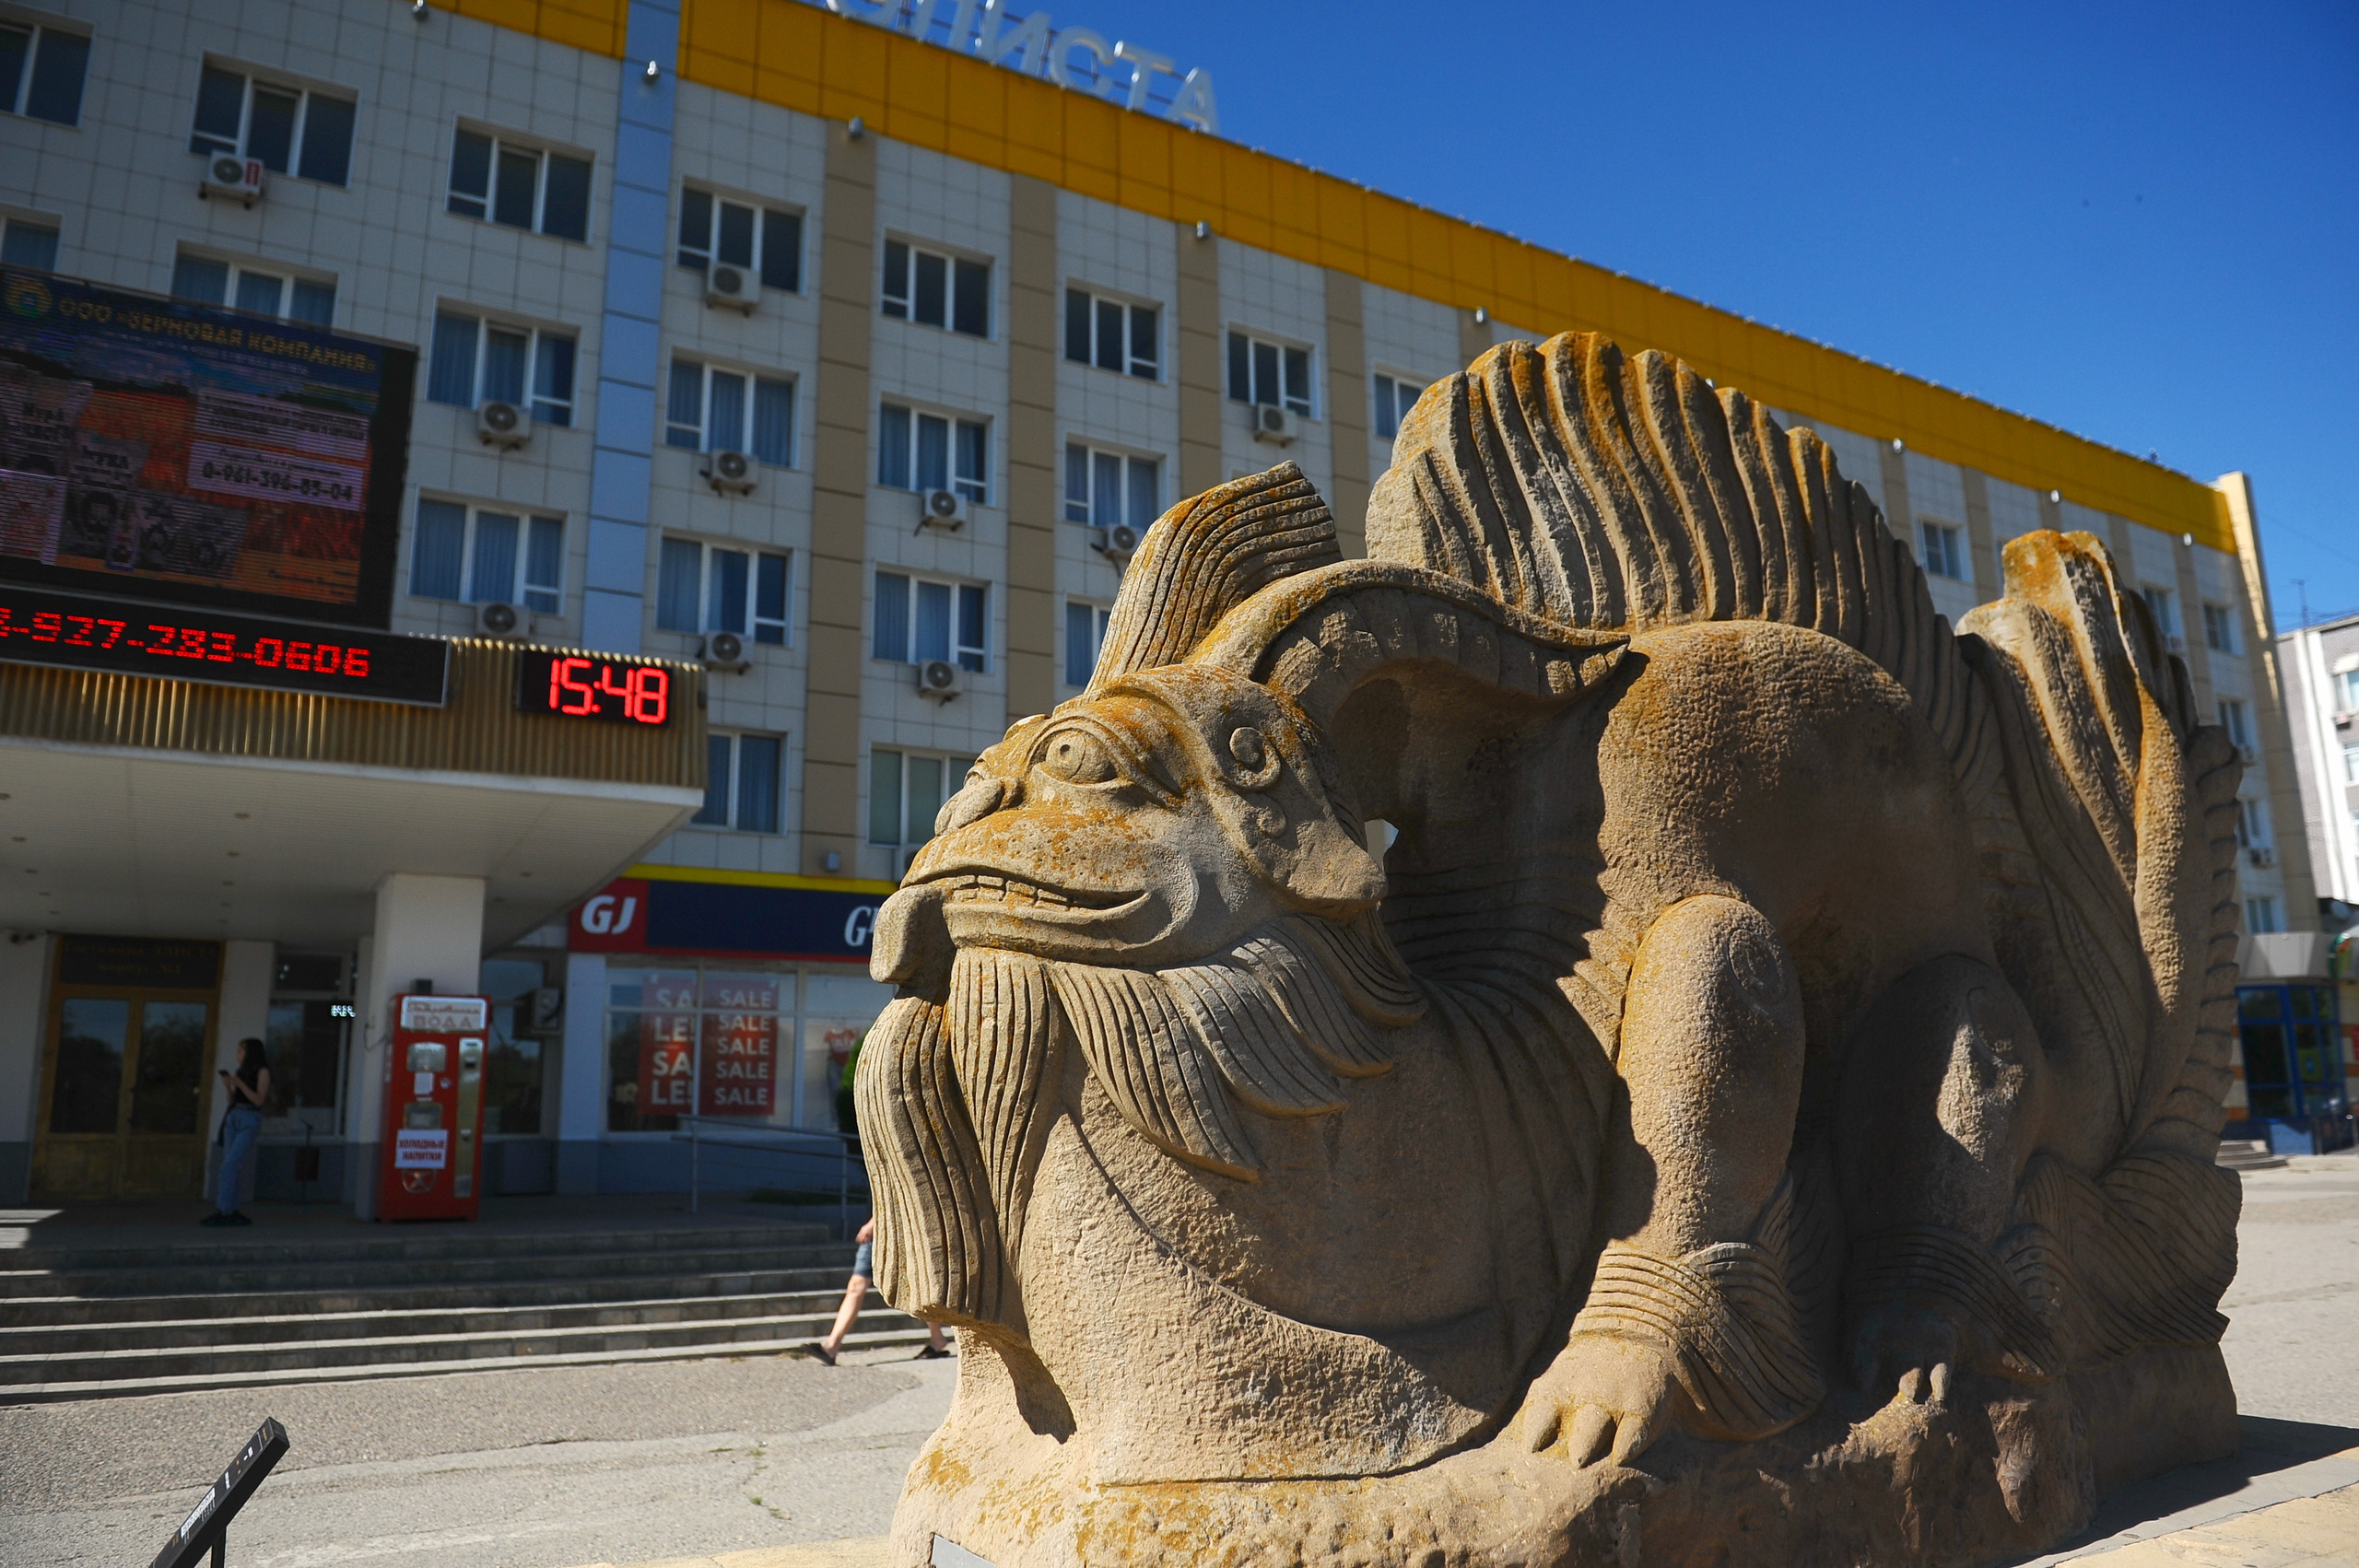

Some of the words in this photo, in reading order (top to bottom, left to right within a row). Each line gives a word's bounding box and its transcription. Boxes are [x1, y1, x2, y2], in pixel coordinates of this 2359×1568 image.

[57, 297, 112, 323] ООО
[549, 657, 668, 723] 15:48
[581, 895, 637, 934] GJ
[719, 989, 772, 1009] SALE
[413, 1015, 473, 1029] ВОДА
[718, 1014, 770, 1033] SALE
[717, 1037, 770, 1056] SALE
[651, 1050, 692, 1077] SA
[715, 1061, 769, 1080] SALE
[714, 1087, 768, 1106] SALE
